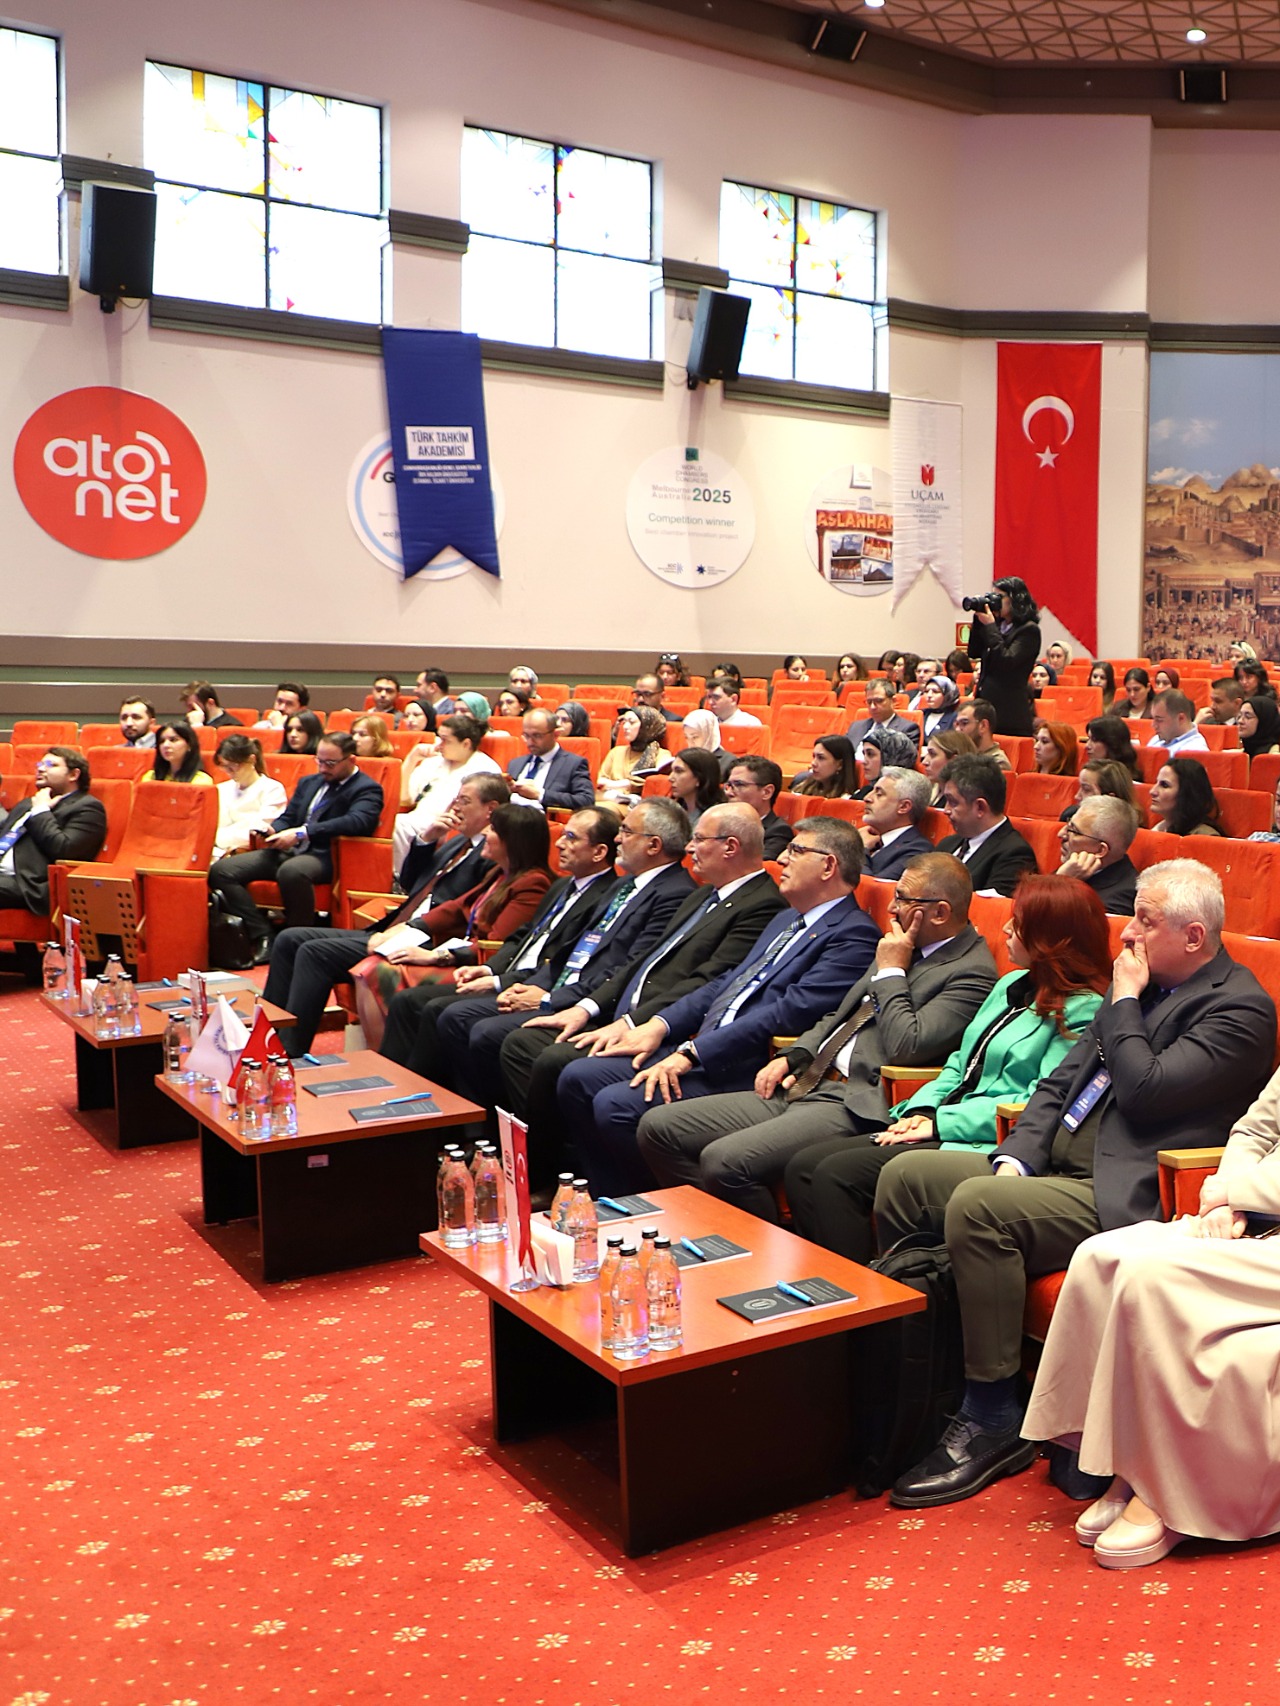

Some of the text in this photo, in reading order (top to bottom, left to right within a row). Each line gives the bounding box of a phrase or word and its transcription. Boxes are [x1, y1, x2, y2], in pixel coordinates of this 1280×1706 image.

[411, 430, 469, 443] TÜRK TAHKİM
[418, 445, 466, 456] AKADEMİSİ
[43, 434, 156, 483] ato
[76, 472, 180, 524] net
[652, 484, 731, 504] Melbourne 2025
[652, 492, 691, 501] Australia
[911, 489, 944, 502] UÇAM
[649, 512, 736, 527] Competition winner
[1225, 864, 1231, 873] 9
